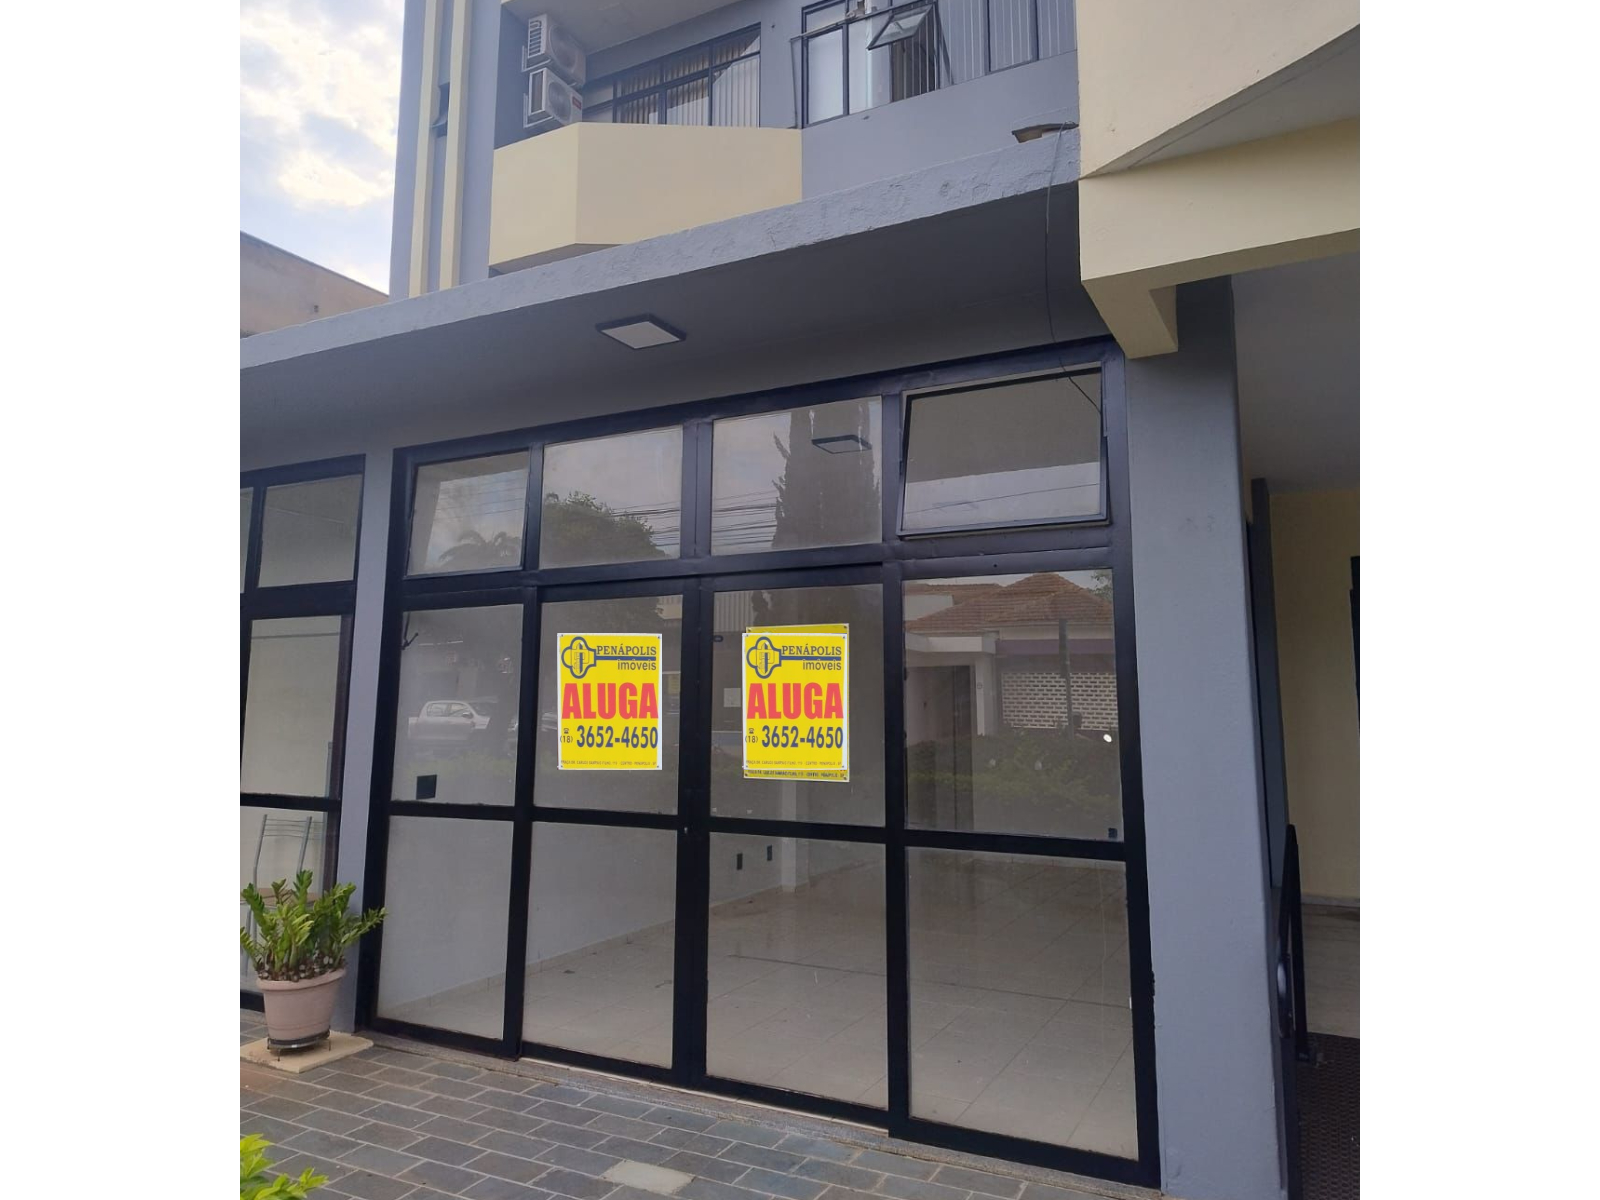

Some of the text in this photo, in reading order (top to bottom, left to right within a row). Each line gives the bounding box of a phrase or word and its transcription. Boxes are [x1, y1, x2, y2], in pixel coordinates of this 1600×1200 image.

[596, 644, 657, 656] PENÁPOLIS
[781, 643, 842, 656] PENÁPOLIS
[617, 659, 657, 671] imóveis
[802, 659, 842, 671] imóveis
[561, 682, 659, 720] ALUGA
[746, 682, 845, 720] ALUGA
[559, 724, 659, 749] (18) 3652-4650
[745, 724, 844, 749] (18) 3652-4650
